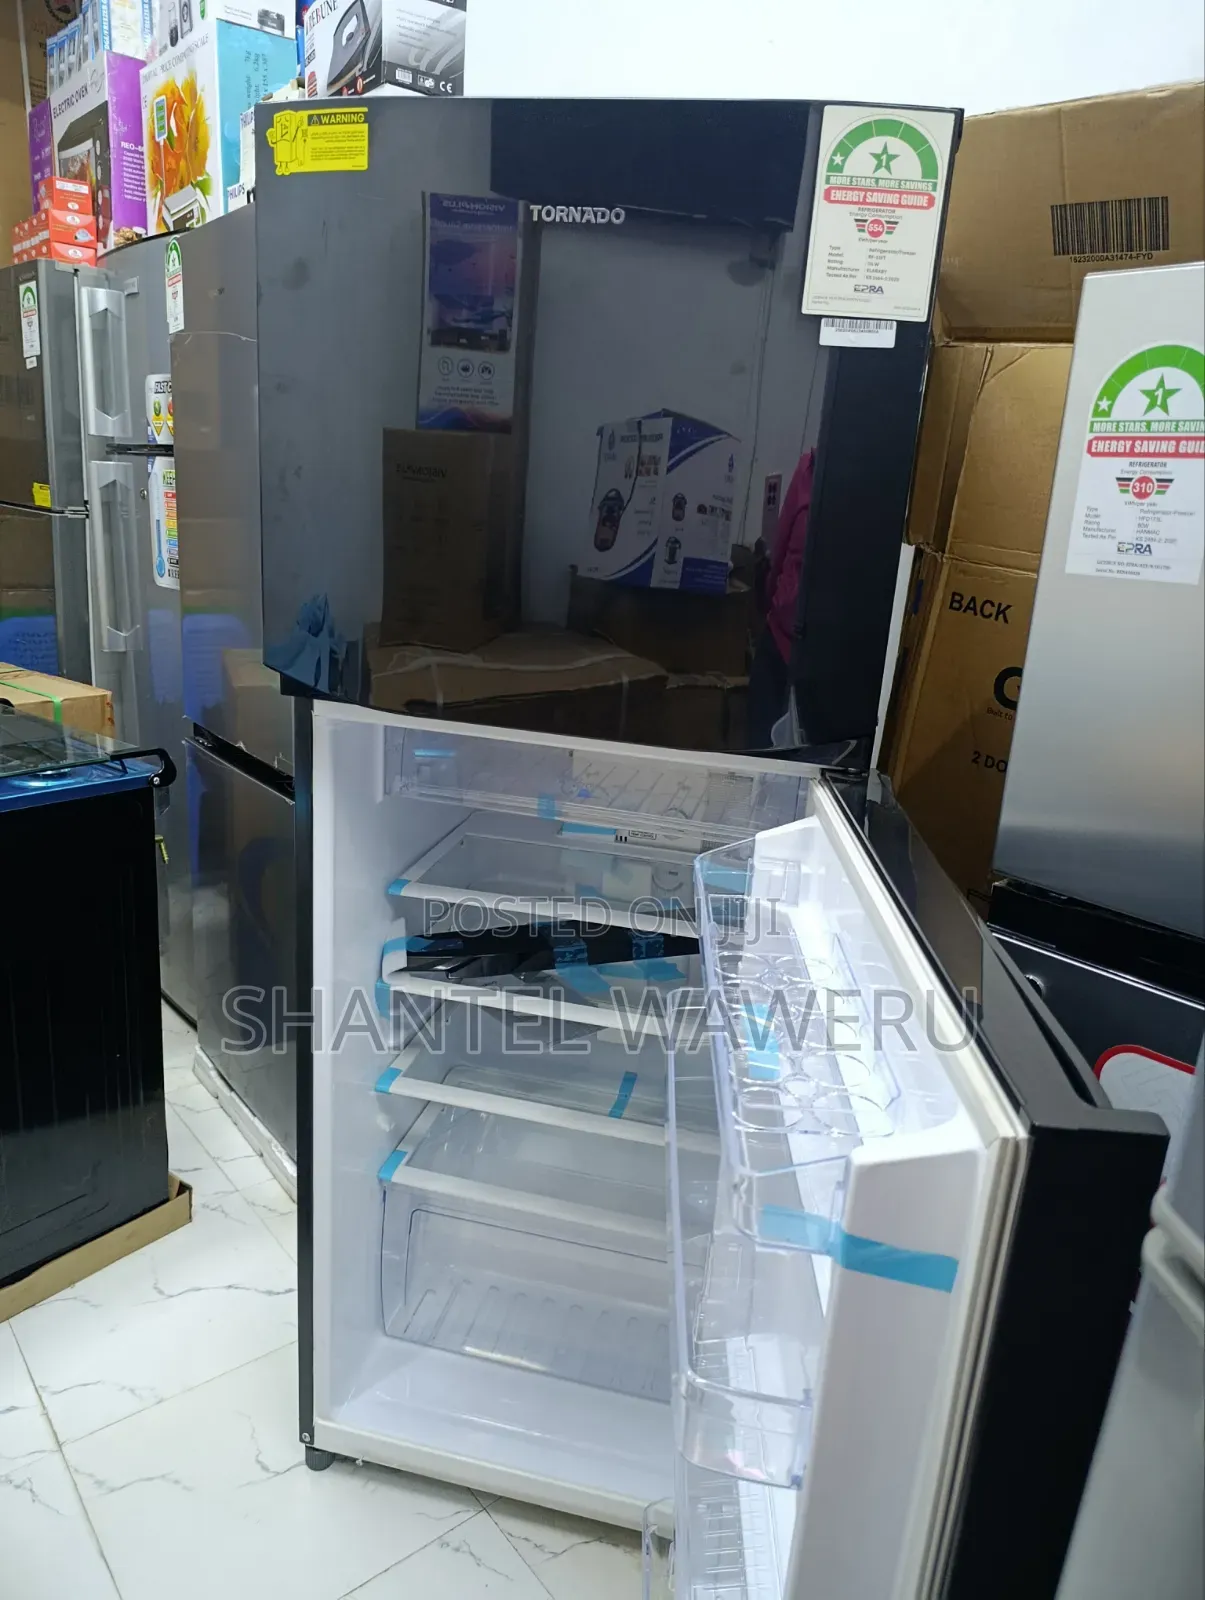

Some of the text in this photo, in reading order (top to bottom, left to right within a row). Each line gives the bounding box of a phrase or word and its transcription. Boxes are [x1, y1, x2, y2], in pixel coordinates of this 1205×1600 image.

[52, 93, 75, 119] ELECTRIC
[75, 82, 89, 103] OVEN
[320, 112, 365, 124] WARNING
[880, 154, 888, 168] 1
[829, 175, 850, 185] MORE
[878, 178, 899, 188] MORE
[900, 180, 932, 191] SAVINGS
[830, 189, 929, 207] ENERGY SAVING GUIDE
[530, 204, 626, 224] TORNADO
[857, 206, 896, 214] REFRIGERATOR
[868, 212, 903, 220] Consumption
[853, 284, 884, 294] EPRA
[154, 381, 166, 394] FAST
[1154, 387, 1164, 407] 1
[1092, 421, 1117, 432] MORE
[1150, 421, 1177, 432] MORE
[1091, 440, 1132, 453] ENERGY
[1134, 440, 1177, 453] SAVING
[1133, 482, 1153, 493] 310
[1117, 541, 1153, 554] EPRA
[948, 591, 1013, 624] BACK
[971, 751, 981, 765] 2
